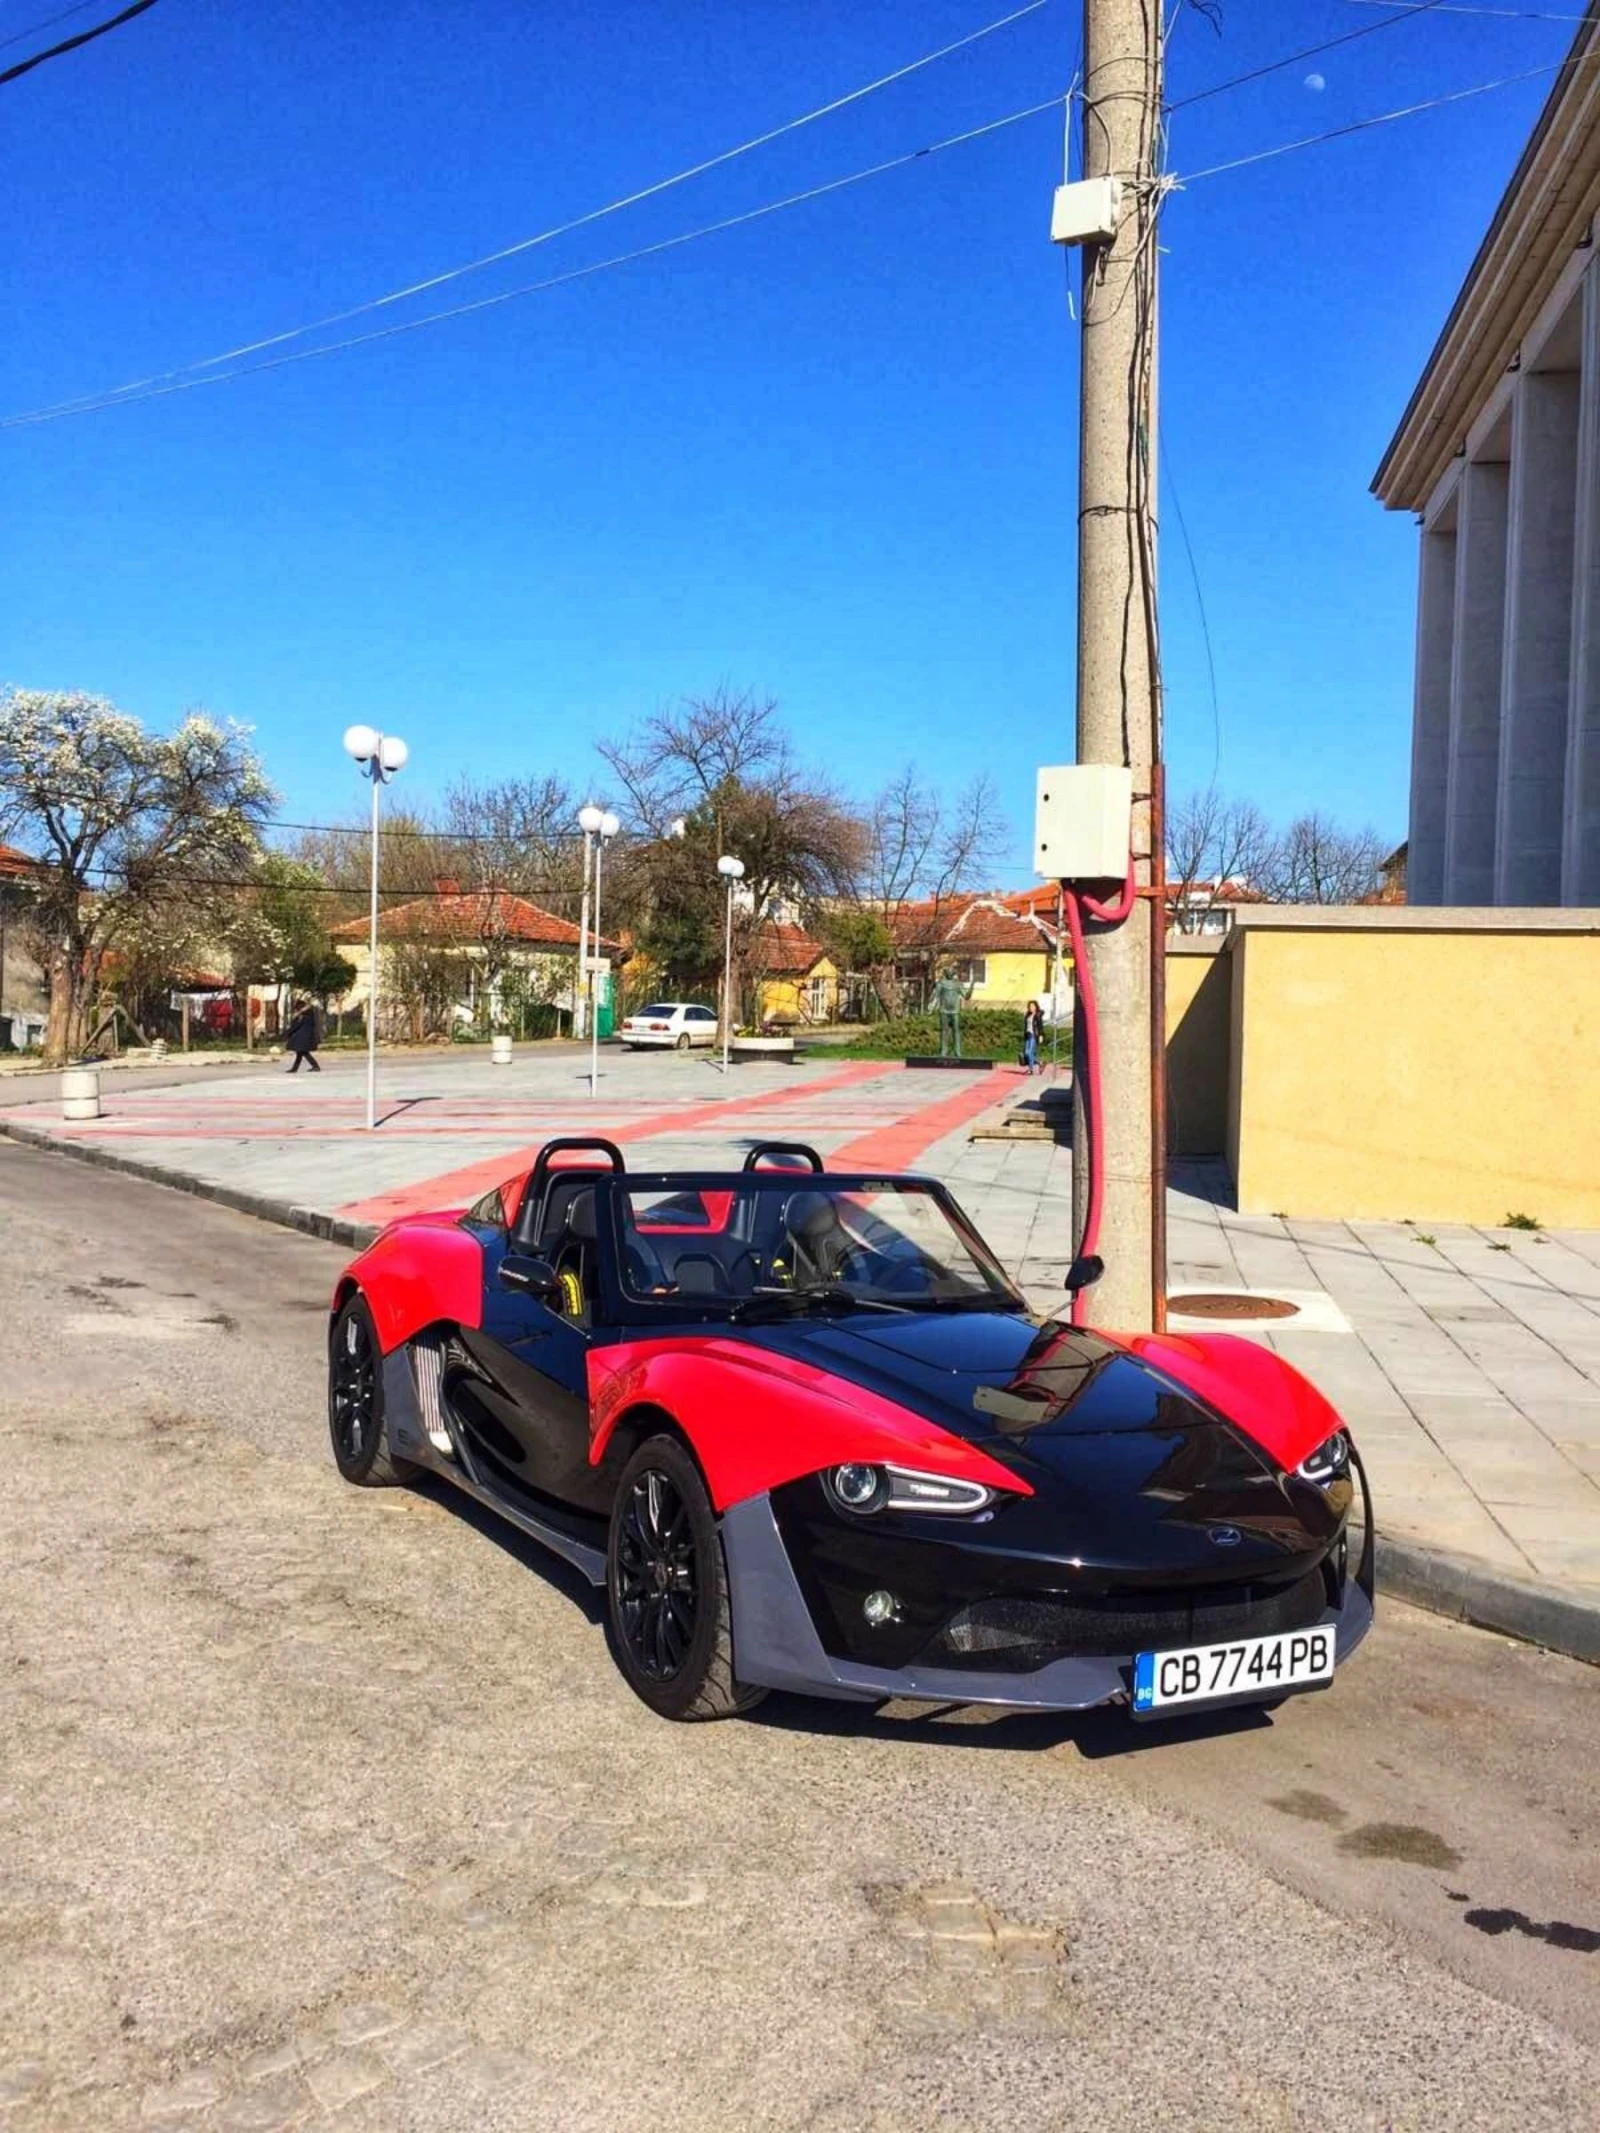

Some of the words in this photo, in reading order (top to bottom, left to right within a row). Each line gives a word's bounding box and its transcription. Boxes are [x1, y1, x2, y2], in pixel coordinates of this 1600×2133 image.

[1160, 1654, 1201, 1697] CB
[1209, 1641, 1283, 1690] 7744
[1290, 1634, 1328, 1677] PB
